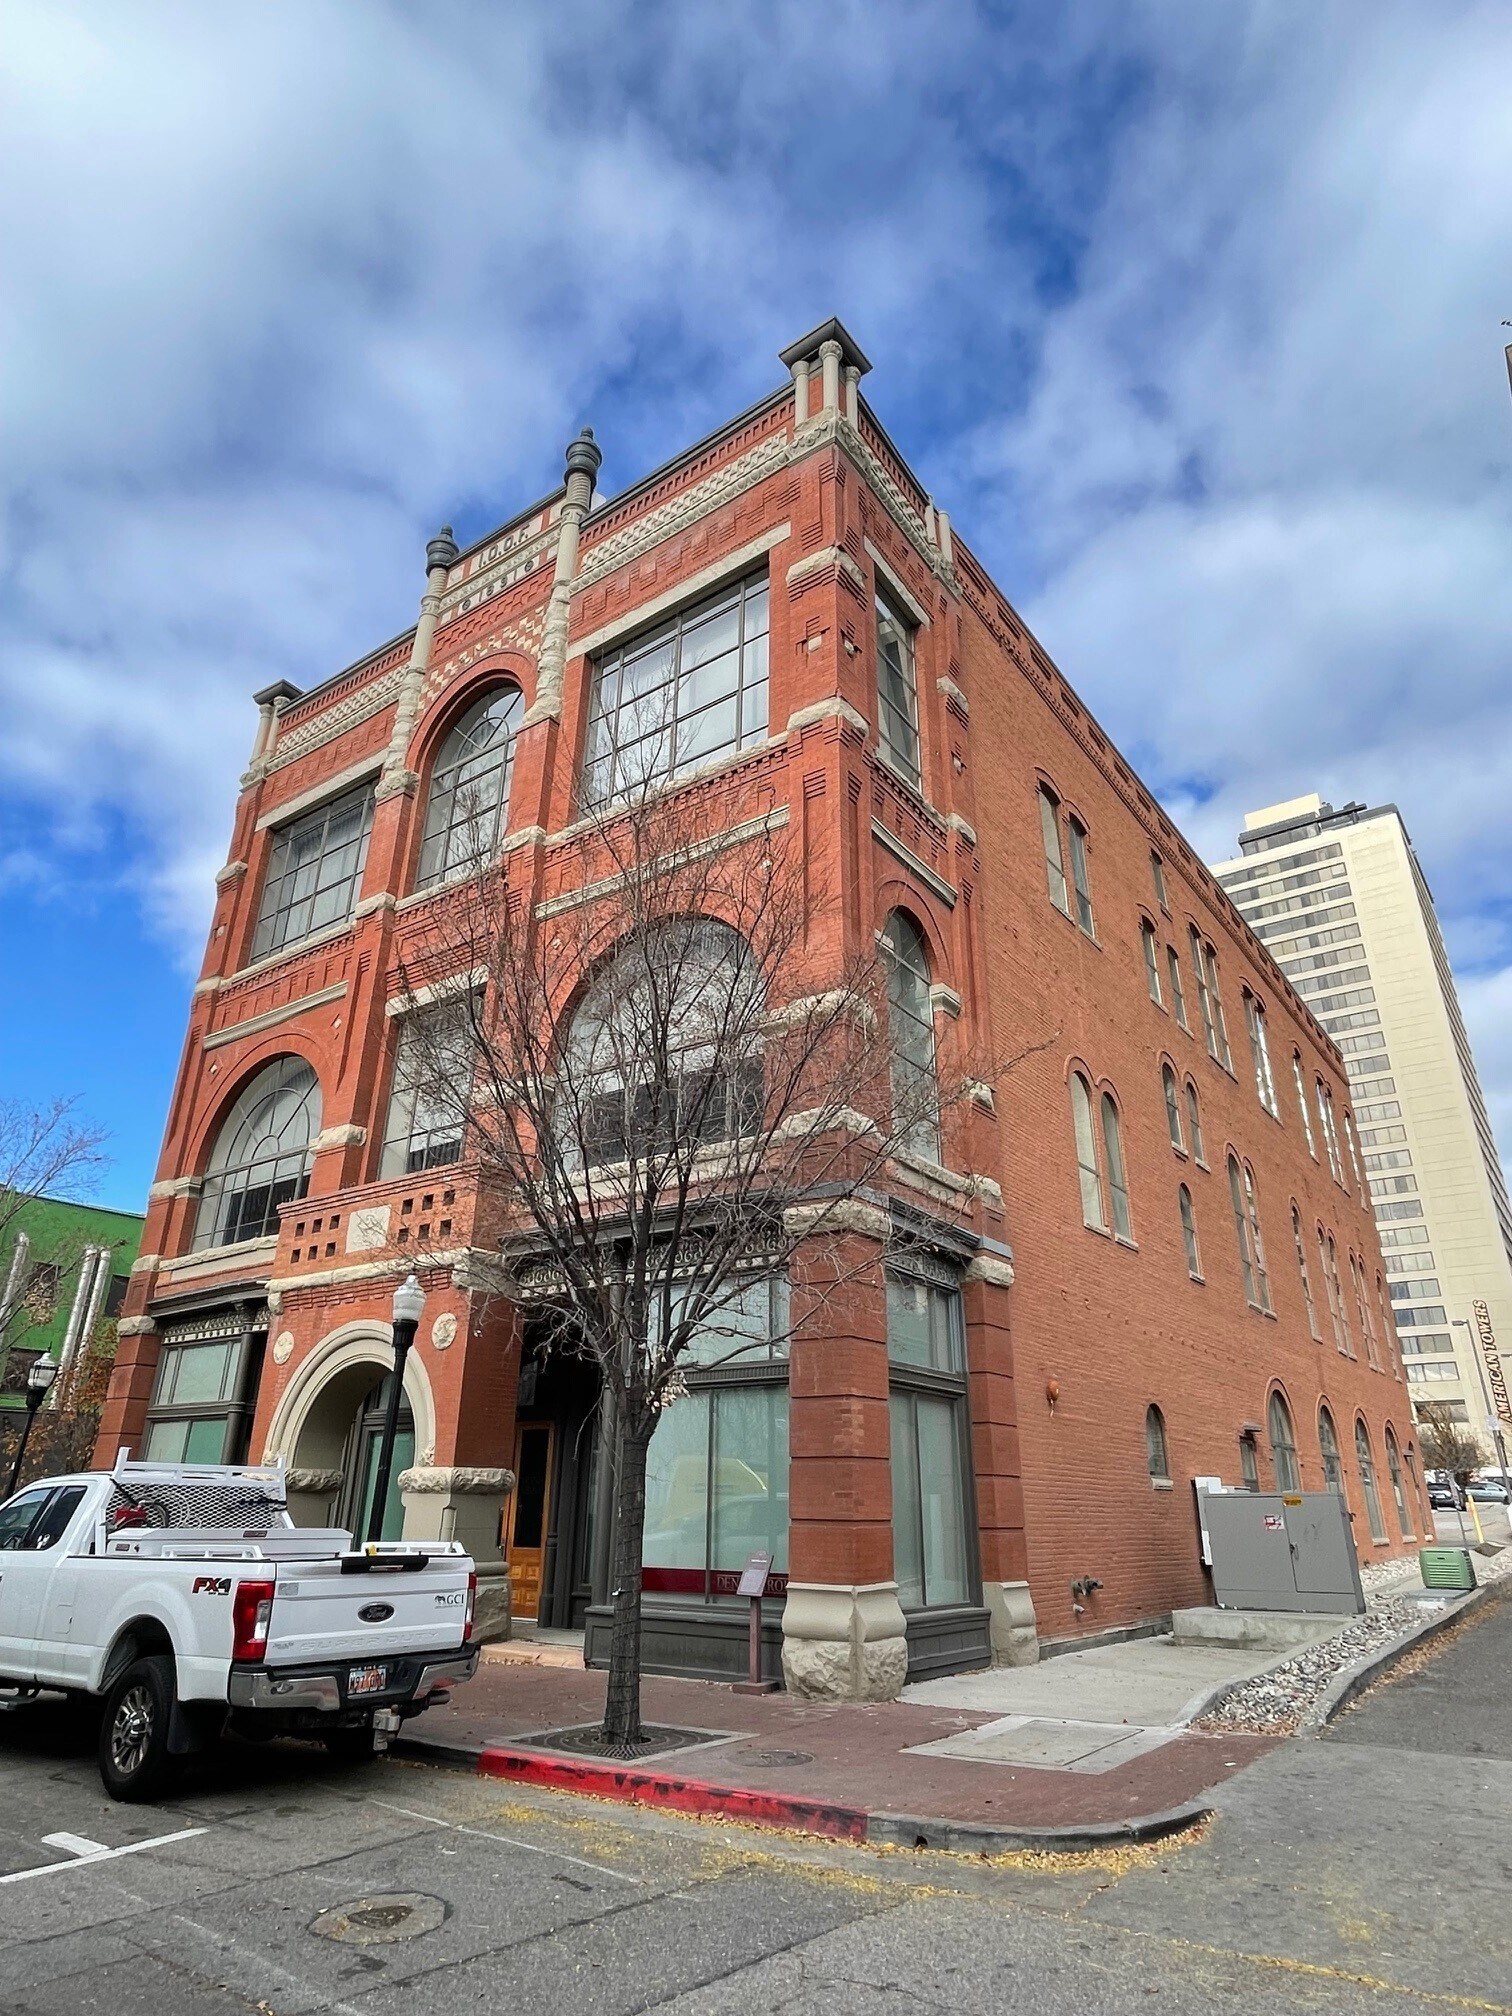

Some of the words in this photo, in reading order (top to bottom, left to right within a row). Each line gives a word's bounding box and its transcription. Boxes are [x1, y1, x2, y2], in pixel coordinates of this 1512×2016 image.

[478, 569, 518, 602] 1891
[1473, 1299, 1497, 1351] TOWERS
[1485, 1354, 1512, 1424] AMERICAN
[192, 1577, 232, 1594] FX4
[717, 1576, 741, 1589] DEN
[447, 1594, 465, 1605] GCI
[300, 1637, 380, 1651] SUPER
[386, 1630, 439, 1644] DUTY
